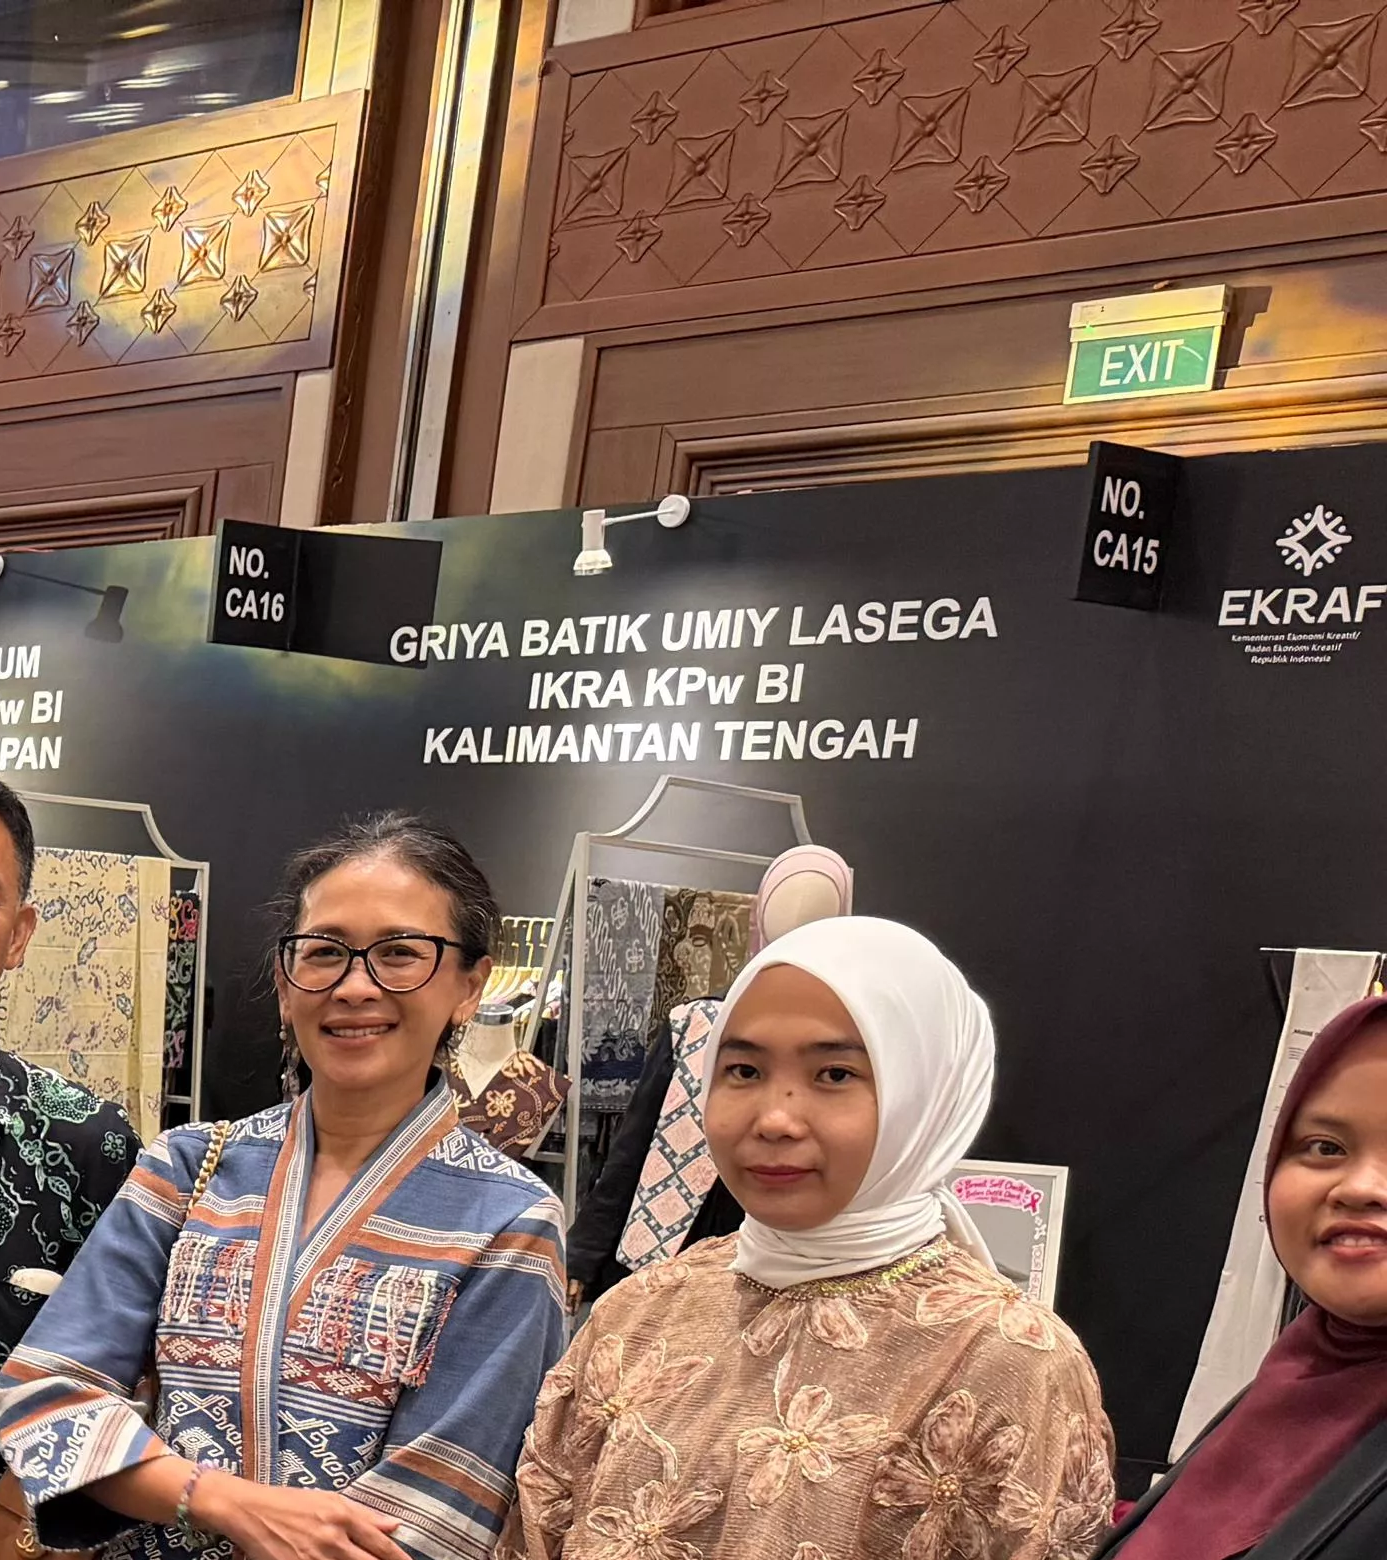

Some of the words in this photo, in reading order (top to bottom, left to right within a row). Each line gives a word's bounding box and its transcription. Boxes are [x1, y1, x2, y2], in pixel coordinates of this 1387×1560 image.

[1099, 339, 1185, 388] EXIT
[1100, 476, 1146, 519] NO.
[229, 546, 269, 579] NO.
[1093, 530, 1160, 575] CA15
[225, 588, 285, 622] CA16
[1218, 585, 1387, 626] EKRAF
[389, 618, 509, 664] GRIYA
[519, 614, 648, 658] BATIK
[661, 604, 778, 652] UMIY
[788, 597, 999, 650] LASEGA
[31, 690, 63, 723] BI
[529, 669, 633, 711] IKRA
[644, 665, 744, 708] KPw
[756, 663, 805, 704] BI
[423, 721, 700, 765] KALIMANTAN
[714, 718, 919, 763] TENGAH
